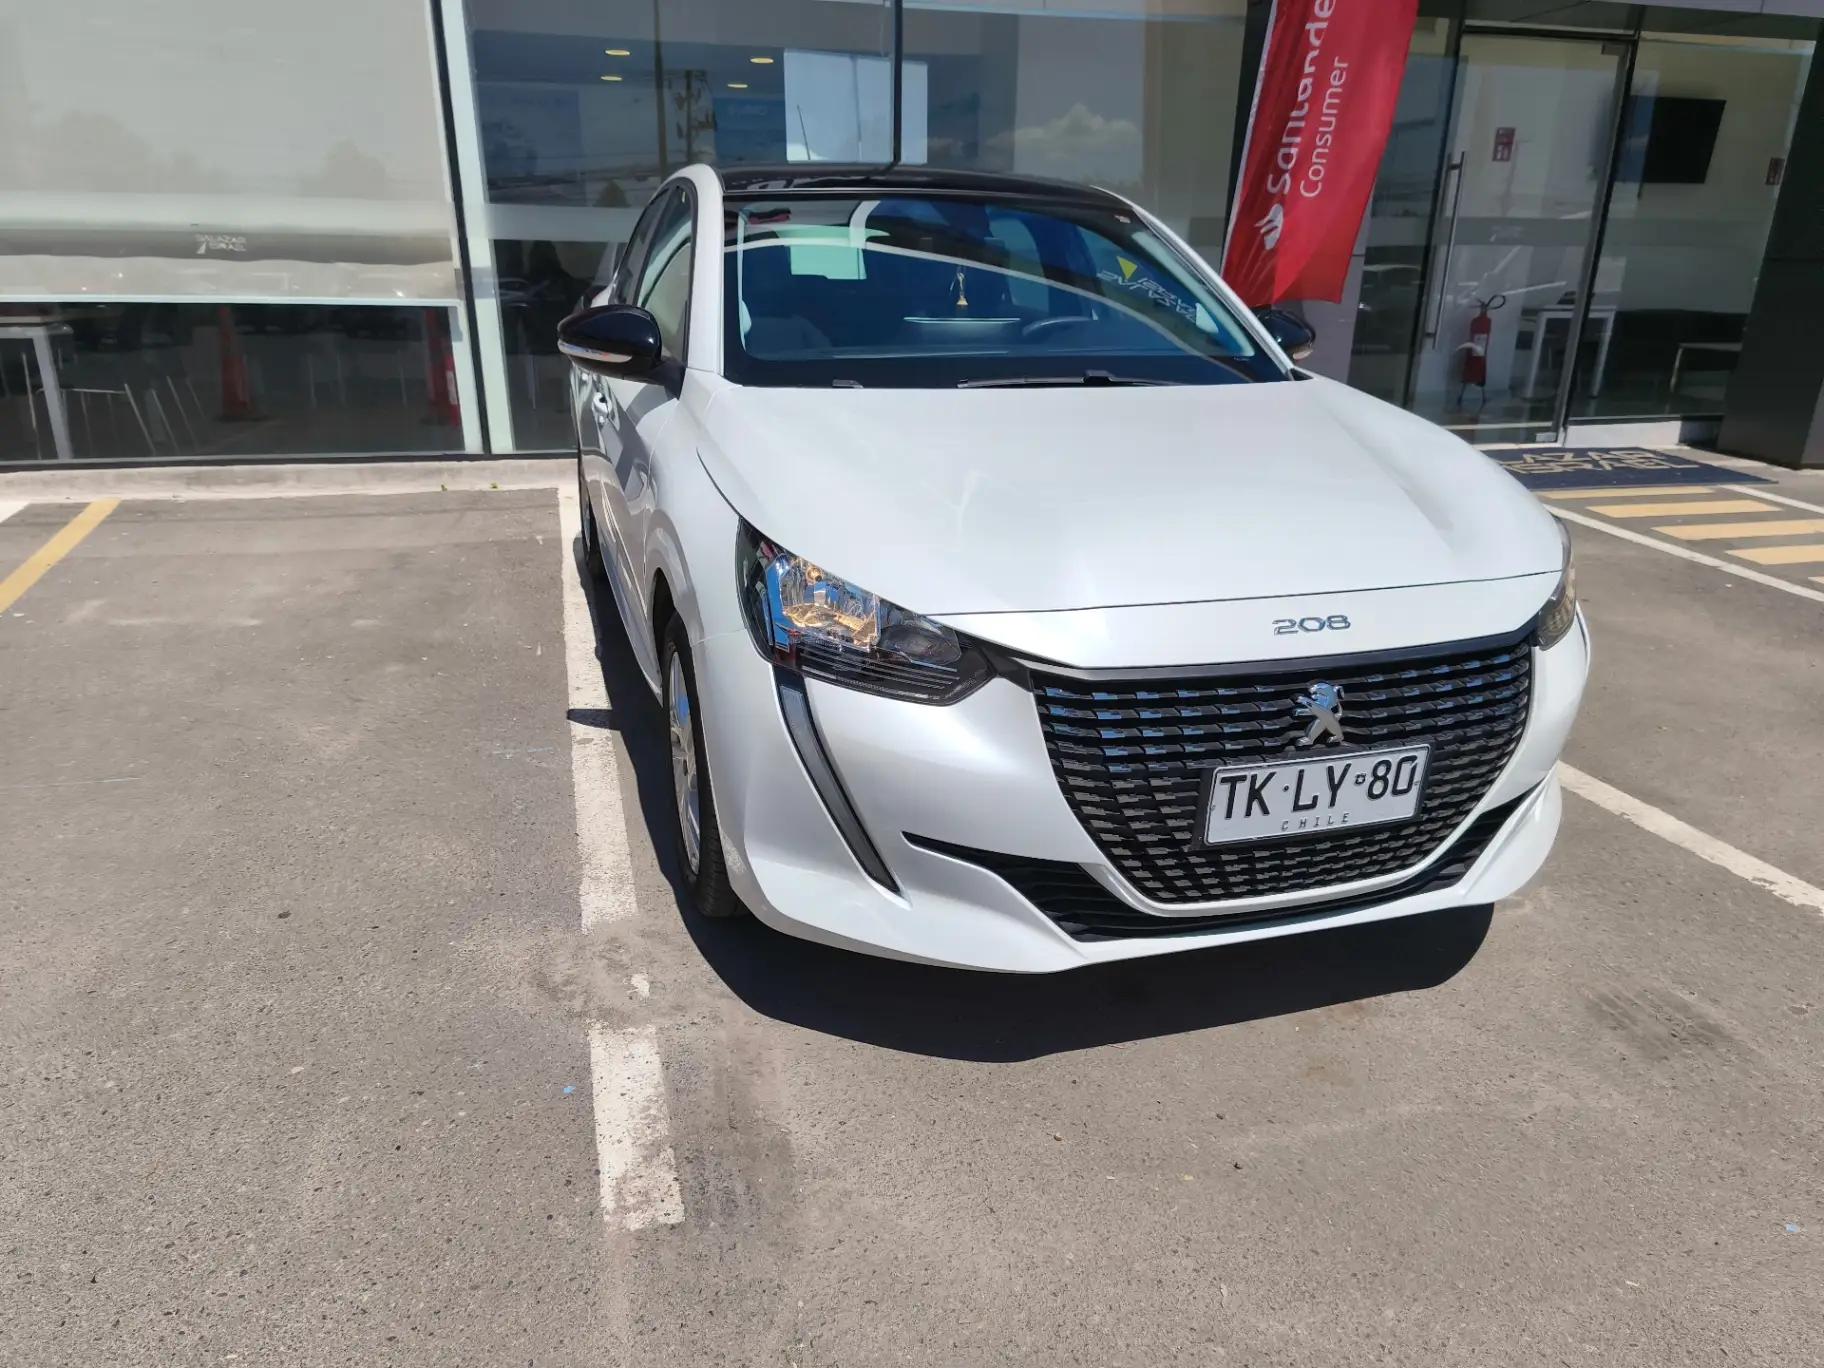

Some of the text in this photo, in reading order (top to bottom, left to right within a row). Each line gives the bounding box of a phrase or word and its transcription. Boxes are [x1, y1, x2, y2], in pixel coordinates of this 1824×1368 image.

[1300, 56, 1349, 198] Consumer
[1271, 614, 1351, 636] 208
[1280, 812, 1351, 832] CHILE
